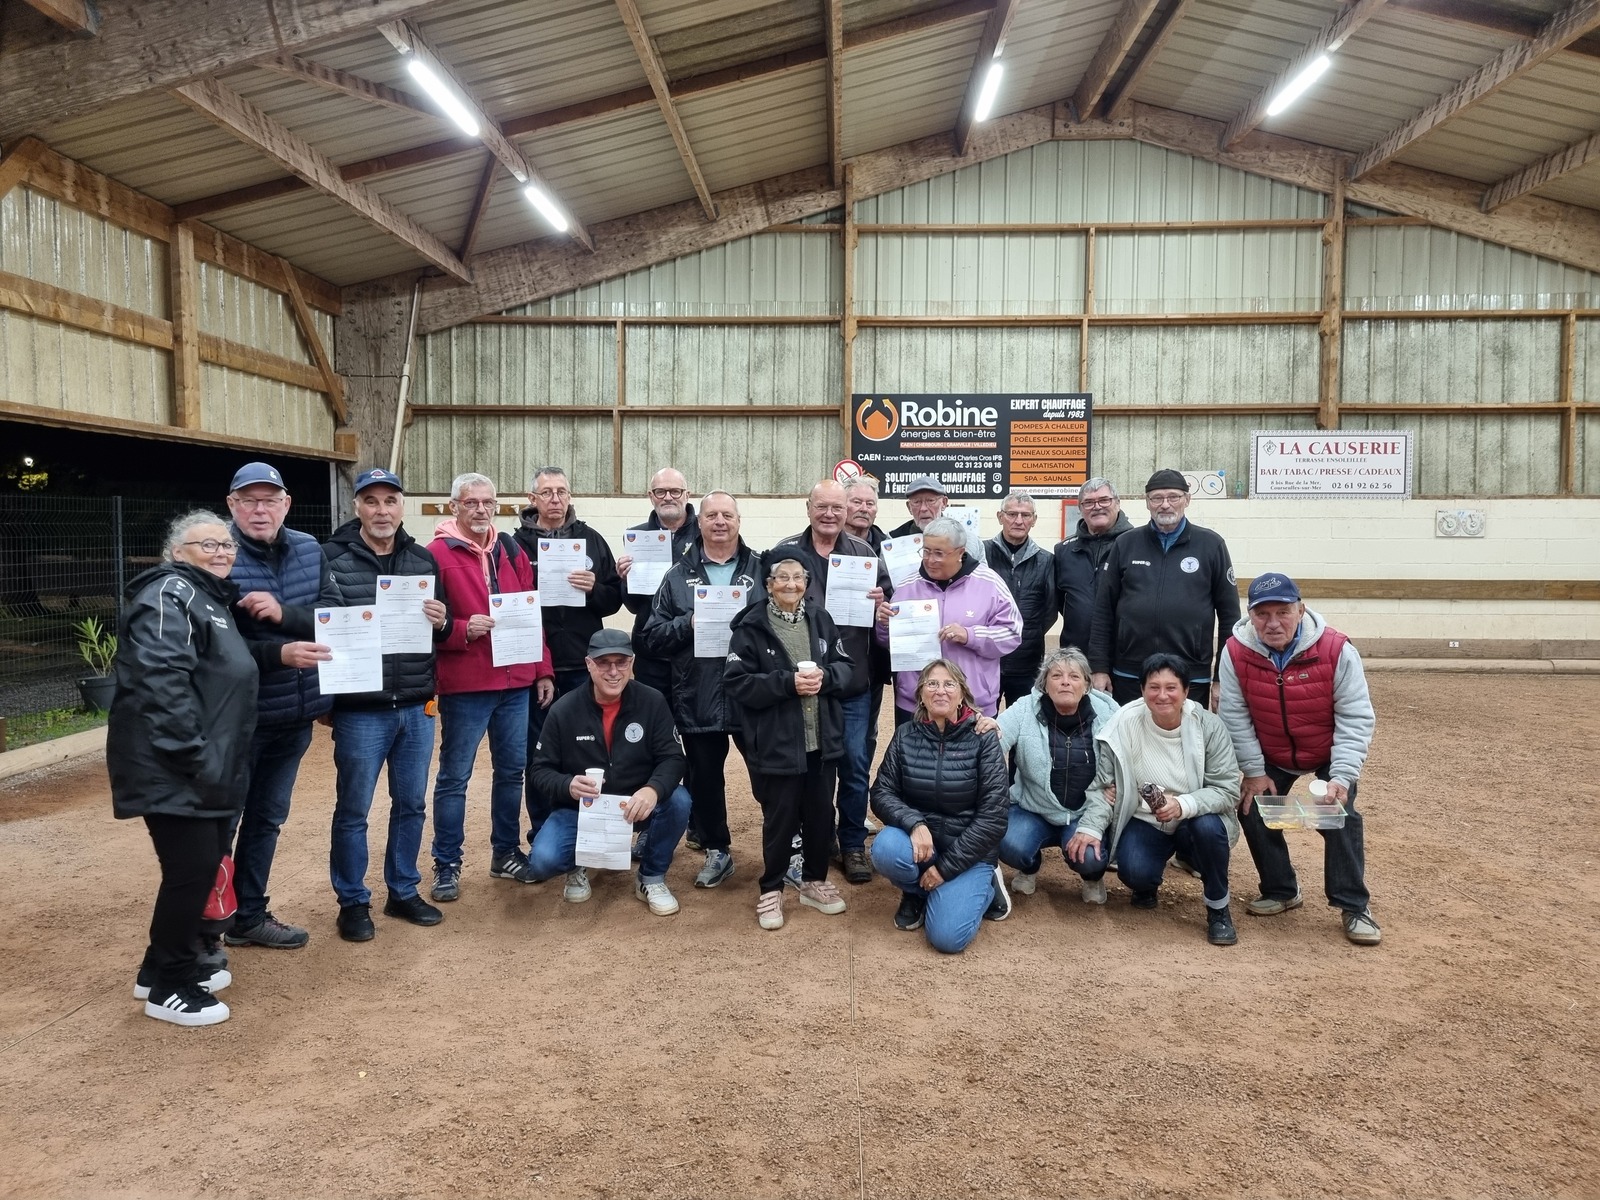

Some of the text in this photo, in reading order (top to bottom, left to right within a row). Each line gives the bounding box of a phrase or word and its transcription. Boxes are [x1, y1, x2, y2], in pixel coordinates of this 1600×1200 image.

[1010, 399, 1086, 410] EXPERT CHAUFFAGE
[901, 399, 998, 426] Robine
[1043, 410, 1065, 420] depuis
[900, 430, 996, 440] énergies & bien-être
[1279, 442, 1400, 455] LA CAUSERIE
[941, 472, 986, 482] CHAUFFAGE
[885, 482, 890, 493] À
[943, 484, 986, 493] UVELABLES
